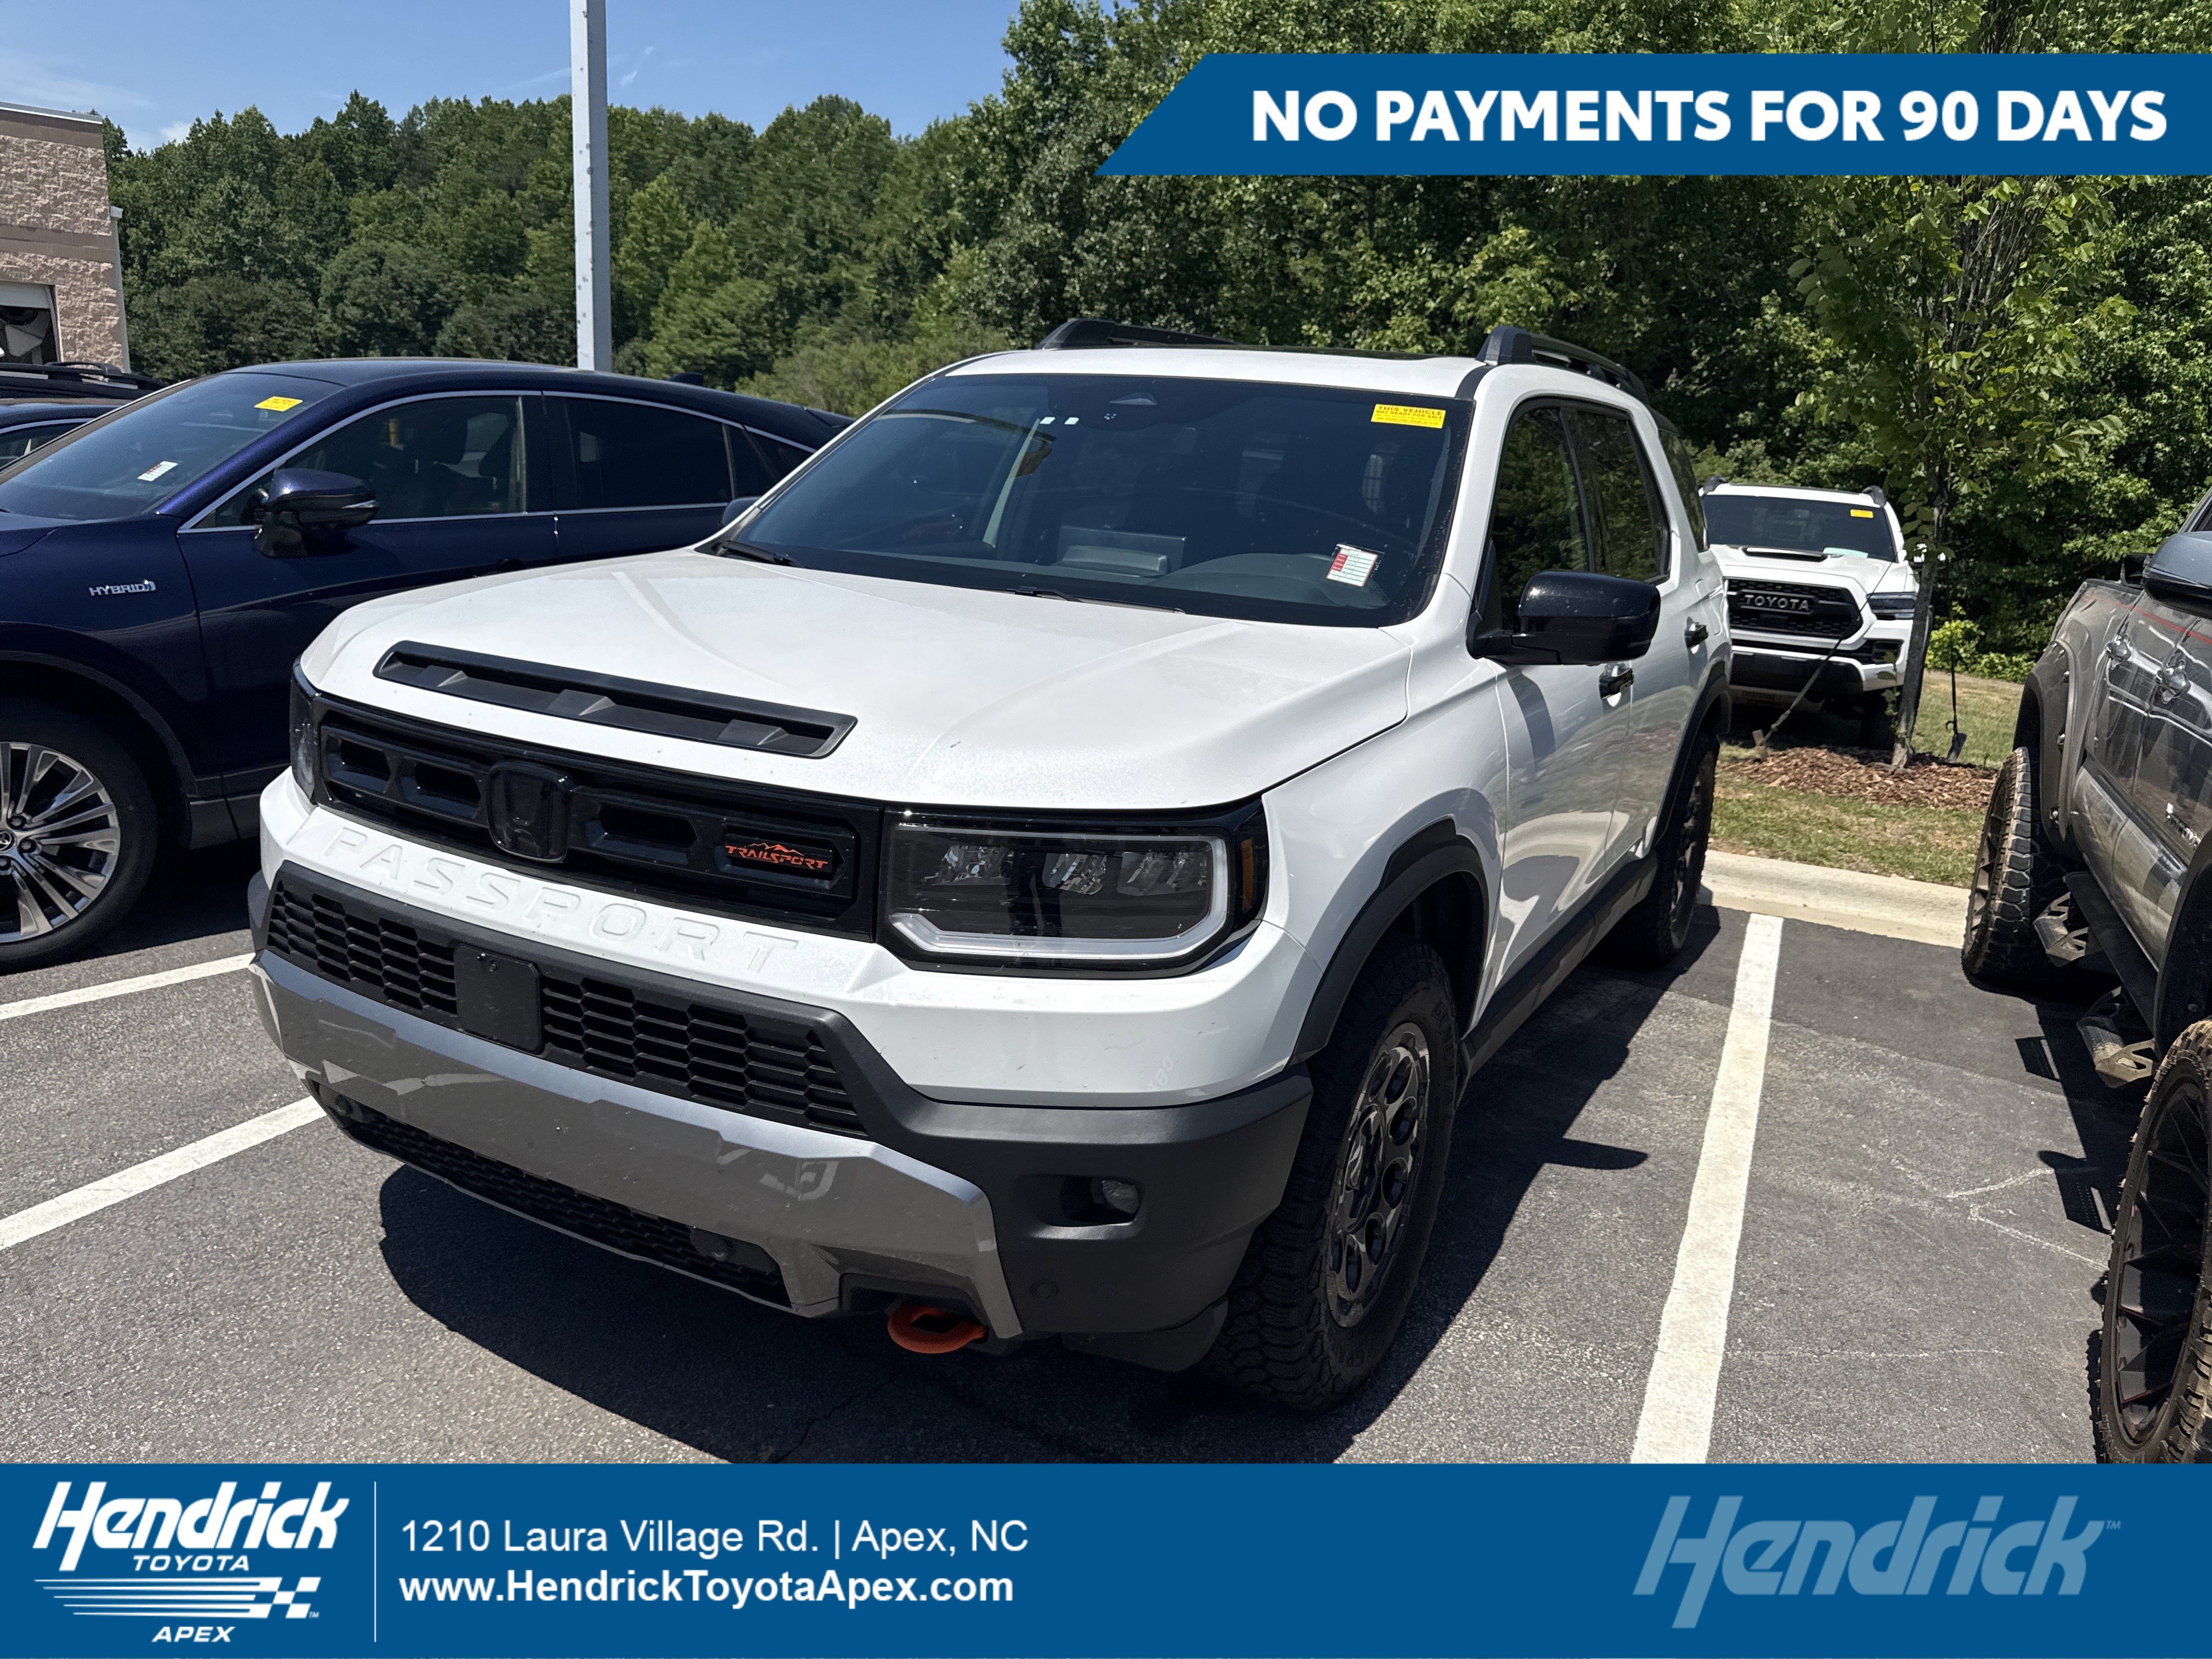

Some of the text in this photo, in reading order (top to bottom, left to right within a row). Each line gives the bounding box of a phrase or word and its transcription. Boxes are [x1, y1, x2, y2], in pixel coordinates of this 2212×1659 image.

[89, 583, 145, 596] HYBRID
[1745, 594, 1809, 611] TOYOTA
[725, 844, 828, 869] TRAILSPORT
[321, 826, 800, 973] PASSPORT
